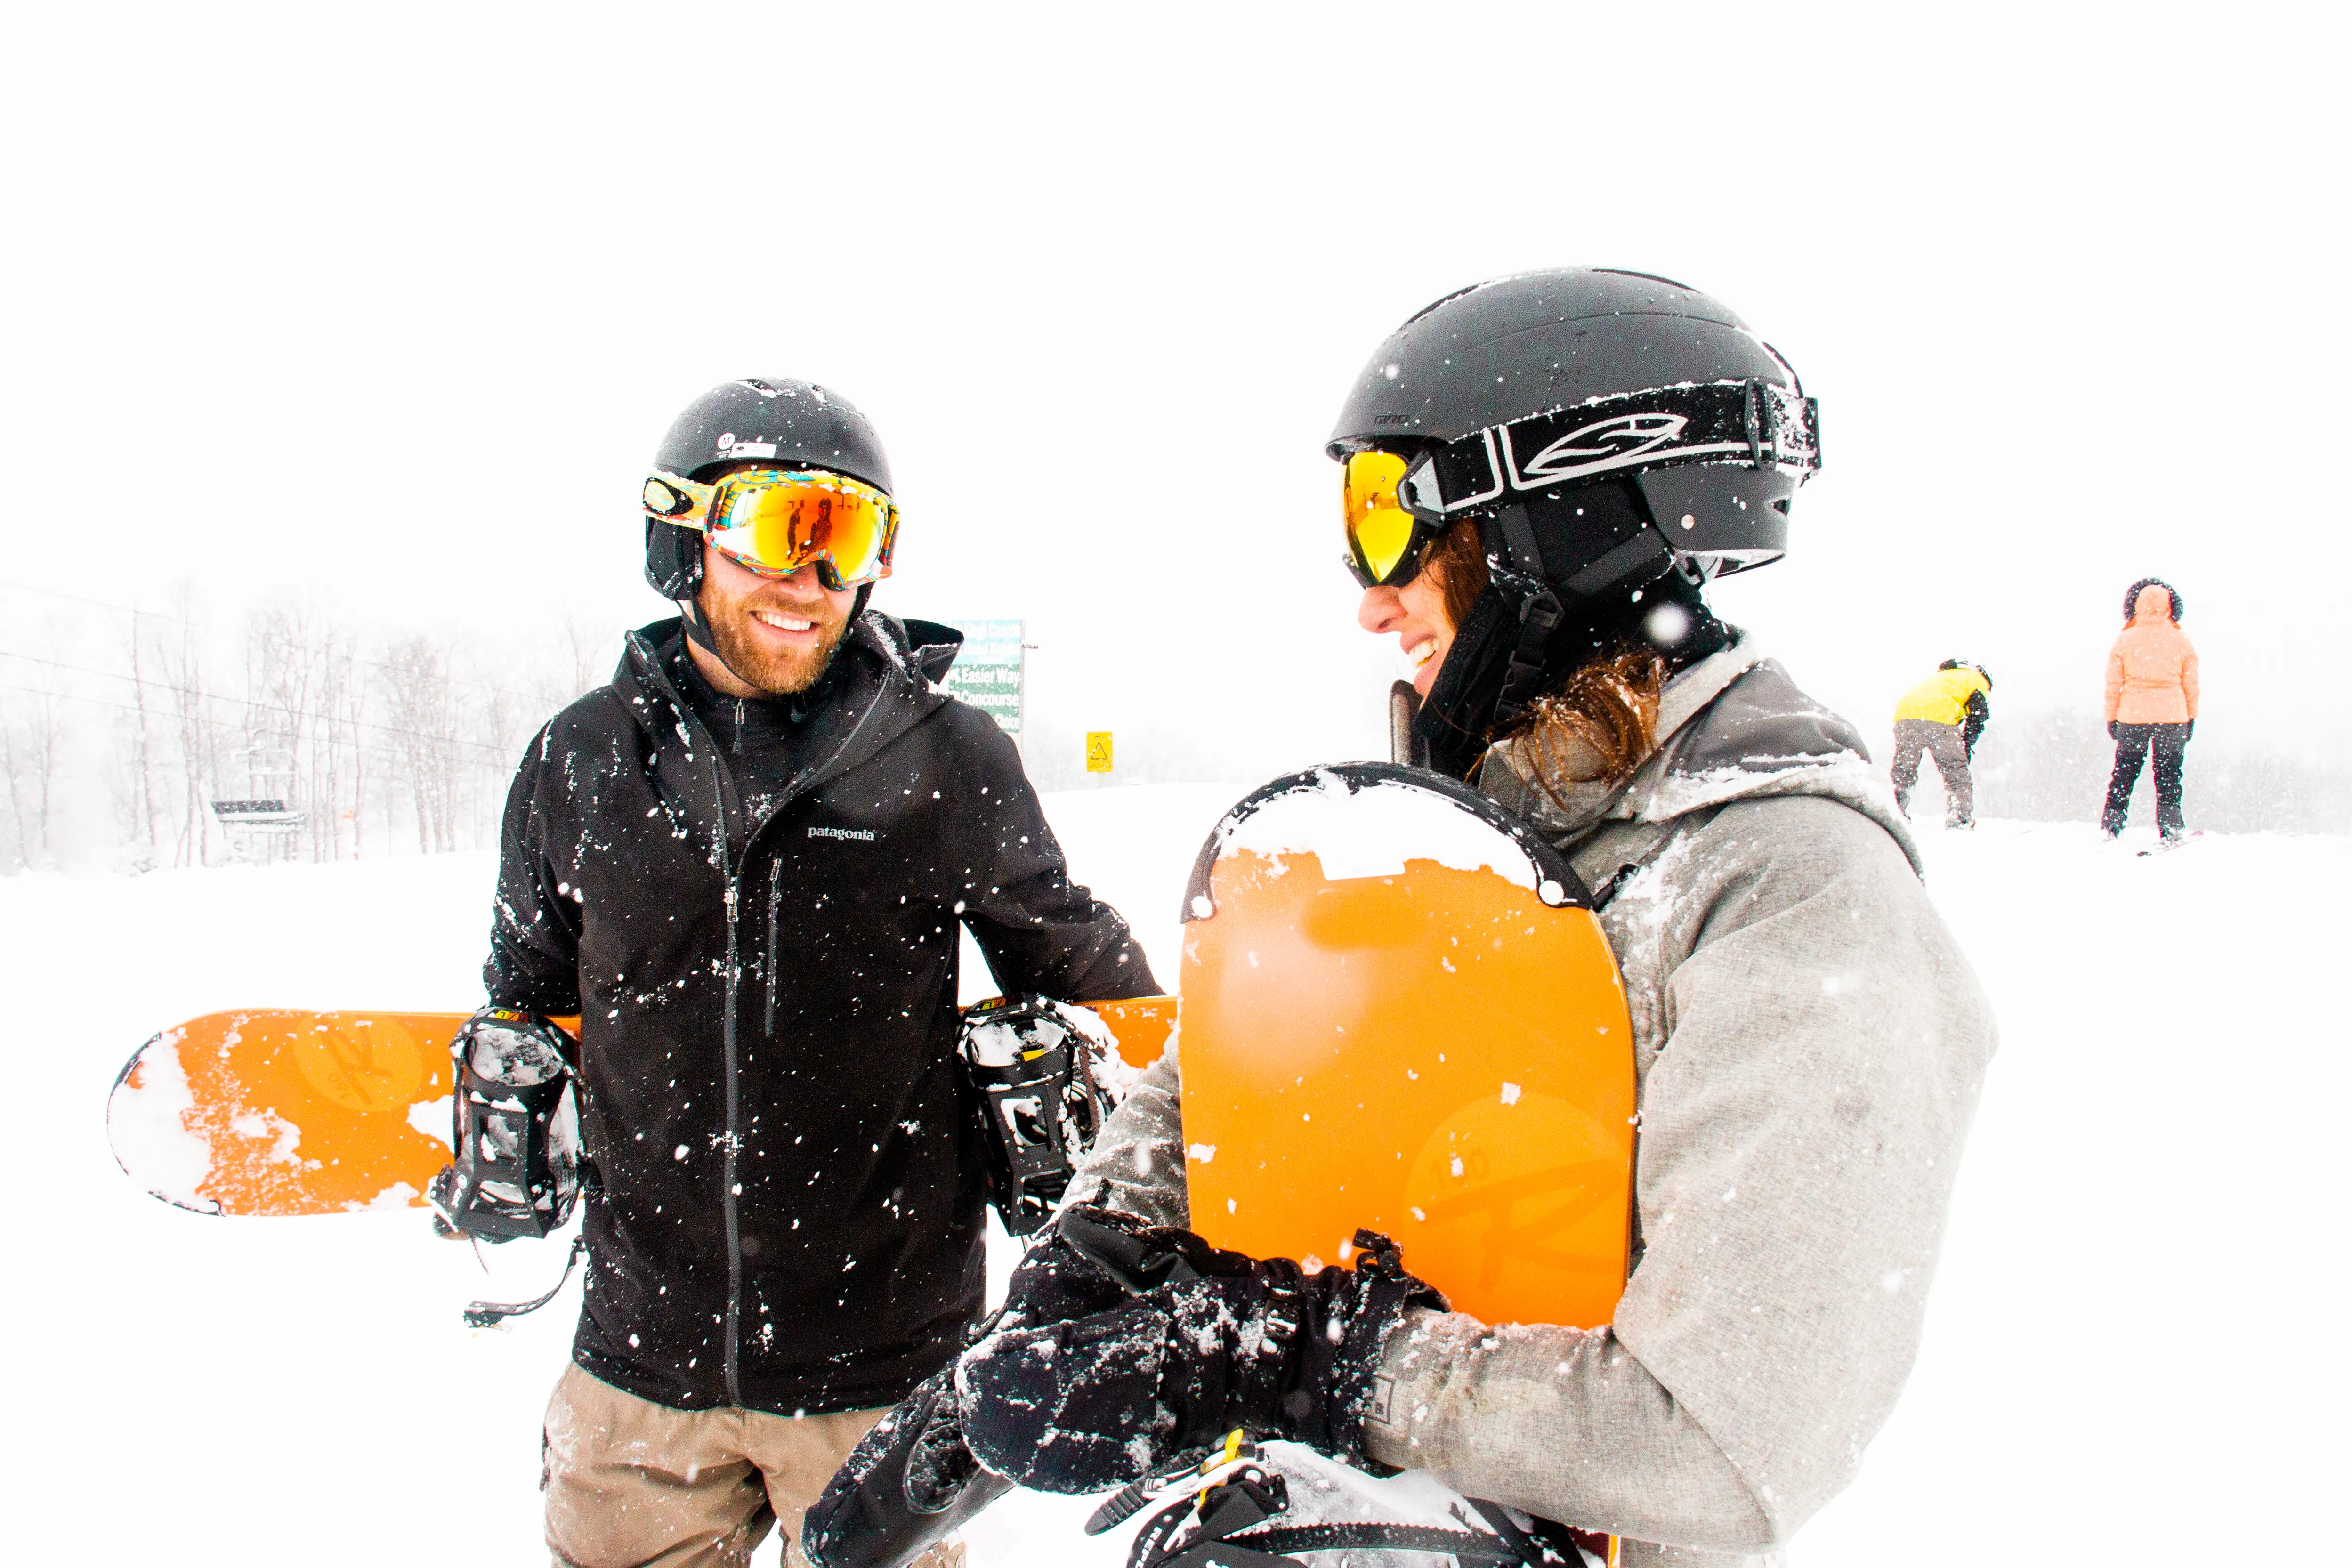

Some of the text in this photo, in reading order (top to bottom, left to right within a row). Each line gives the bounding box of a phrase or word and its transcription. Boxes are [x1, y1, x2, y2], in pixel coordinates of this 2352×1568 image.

[1374, 414, 1408, 424] GIRO
[721, 436, 731, 445] M
[963, 641, 988, 655] Good
[962, 667, 1020, 688] Easier Way
[961, 690, 1019, 706] Concourse
[807, 826, 874, 841] patagonia
